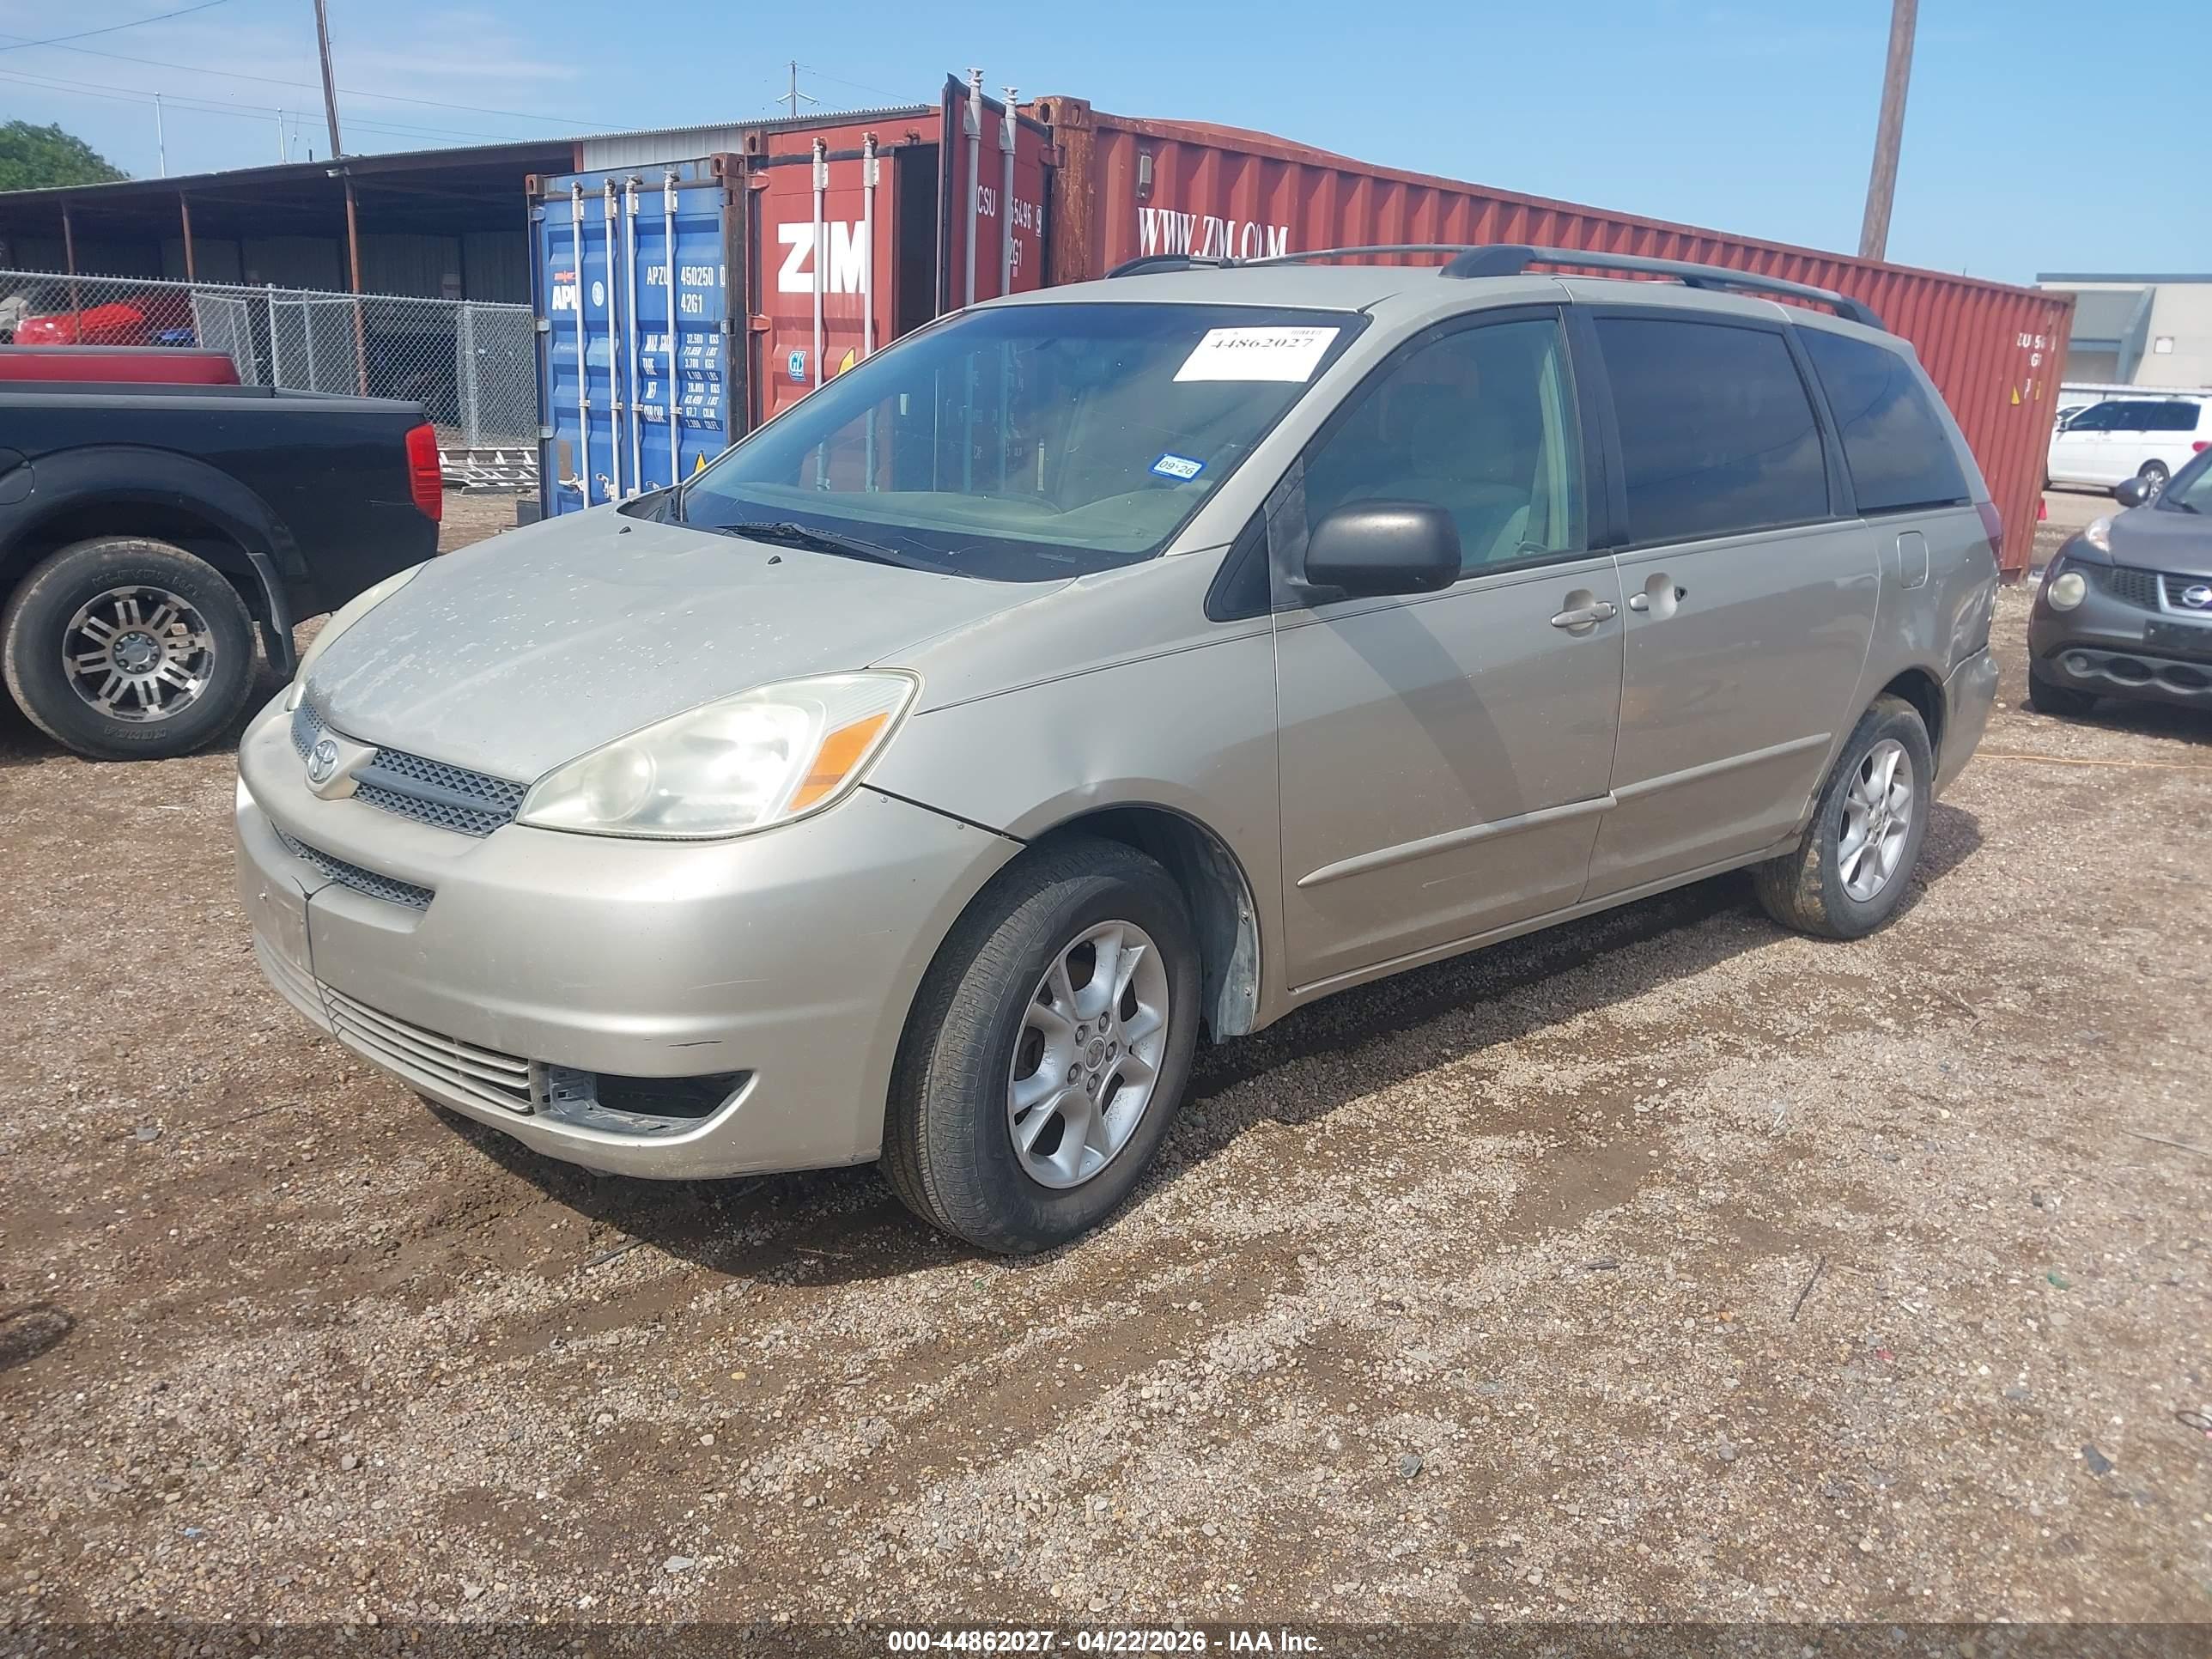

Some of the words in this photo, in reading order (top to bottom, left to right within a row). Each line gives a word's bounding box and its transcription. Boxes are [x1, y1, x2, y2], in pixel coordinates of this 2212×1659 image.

[778, 220, 866, 293] ZIM
[681, 266, 714, 286] 450250
[681, 294, 702, 313] 42G1
[1211, 338, 1315, 349] 44862027
